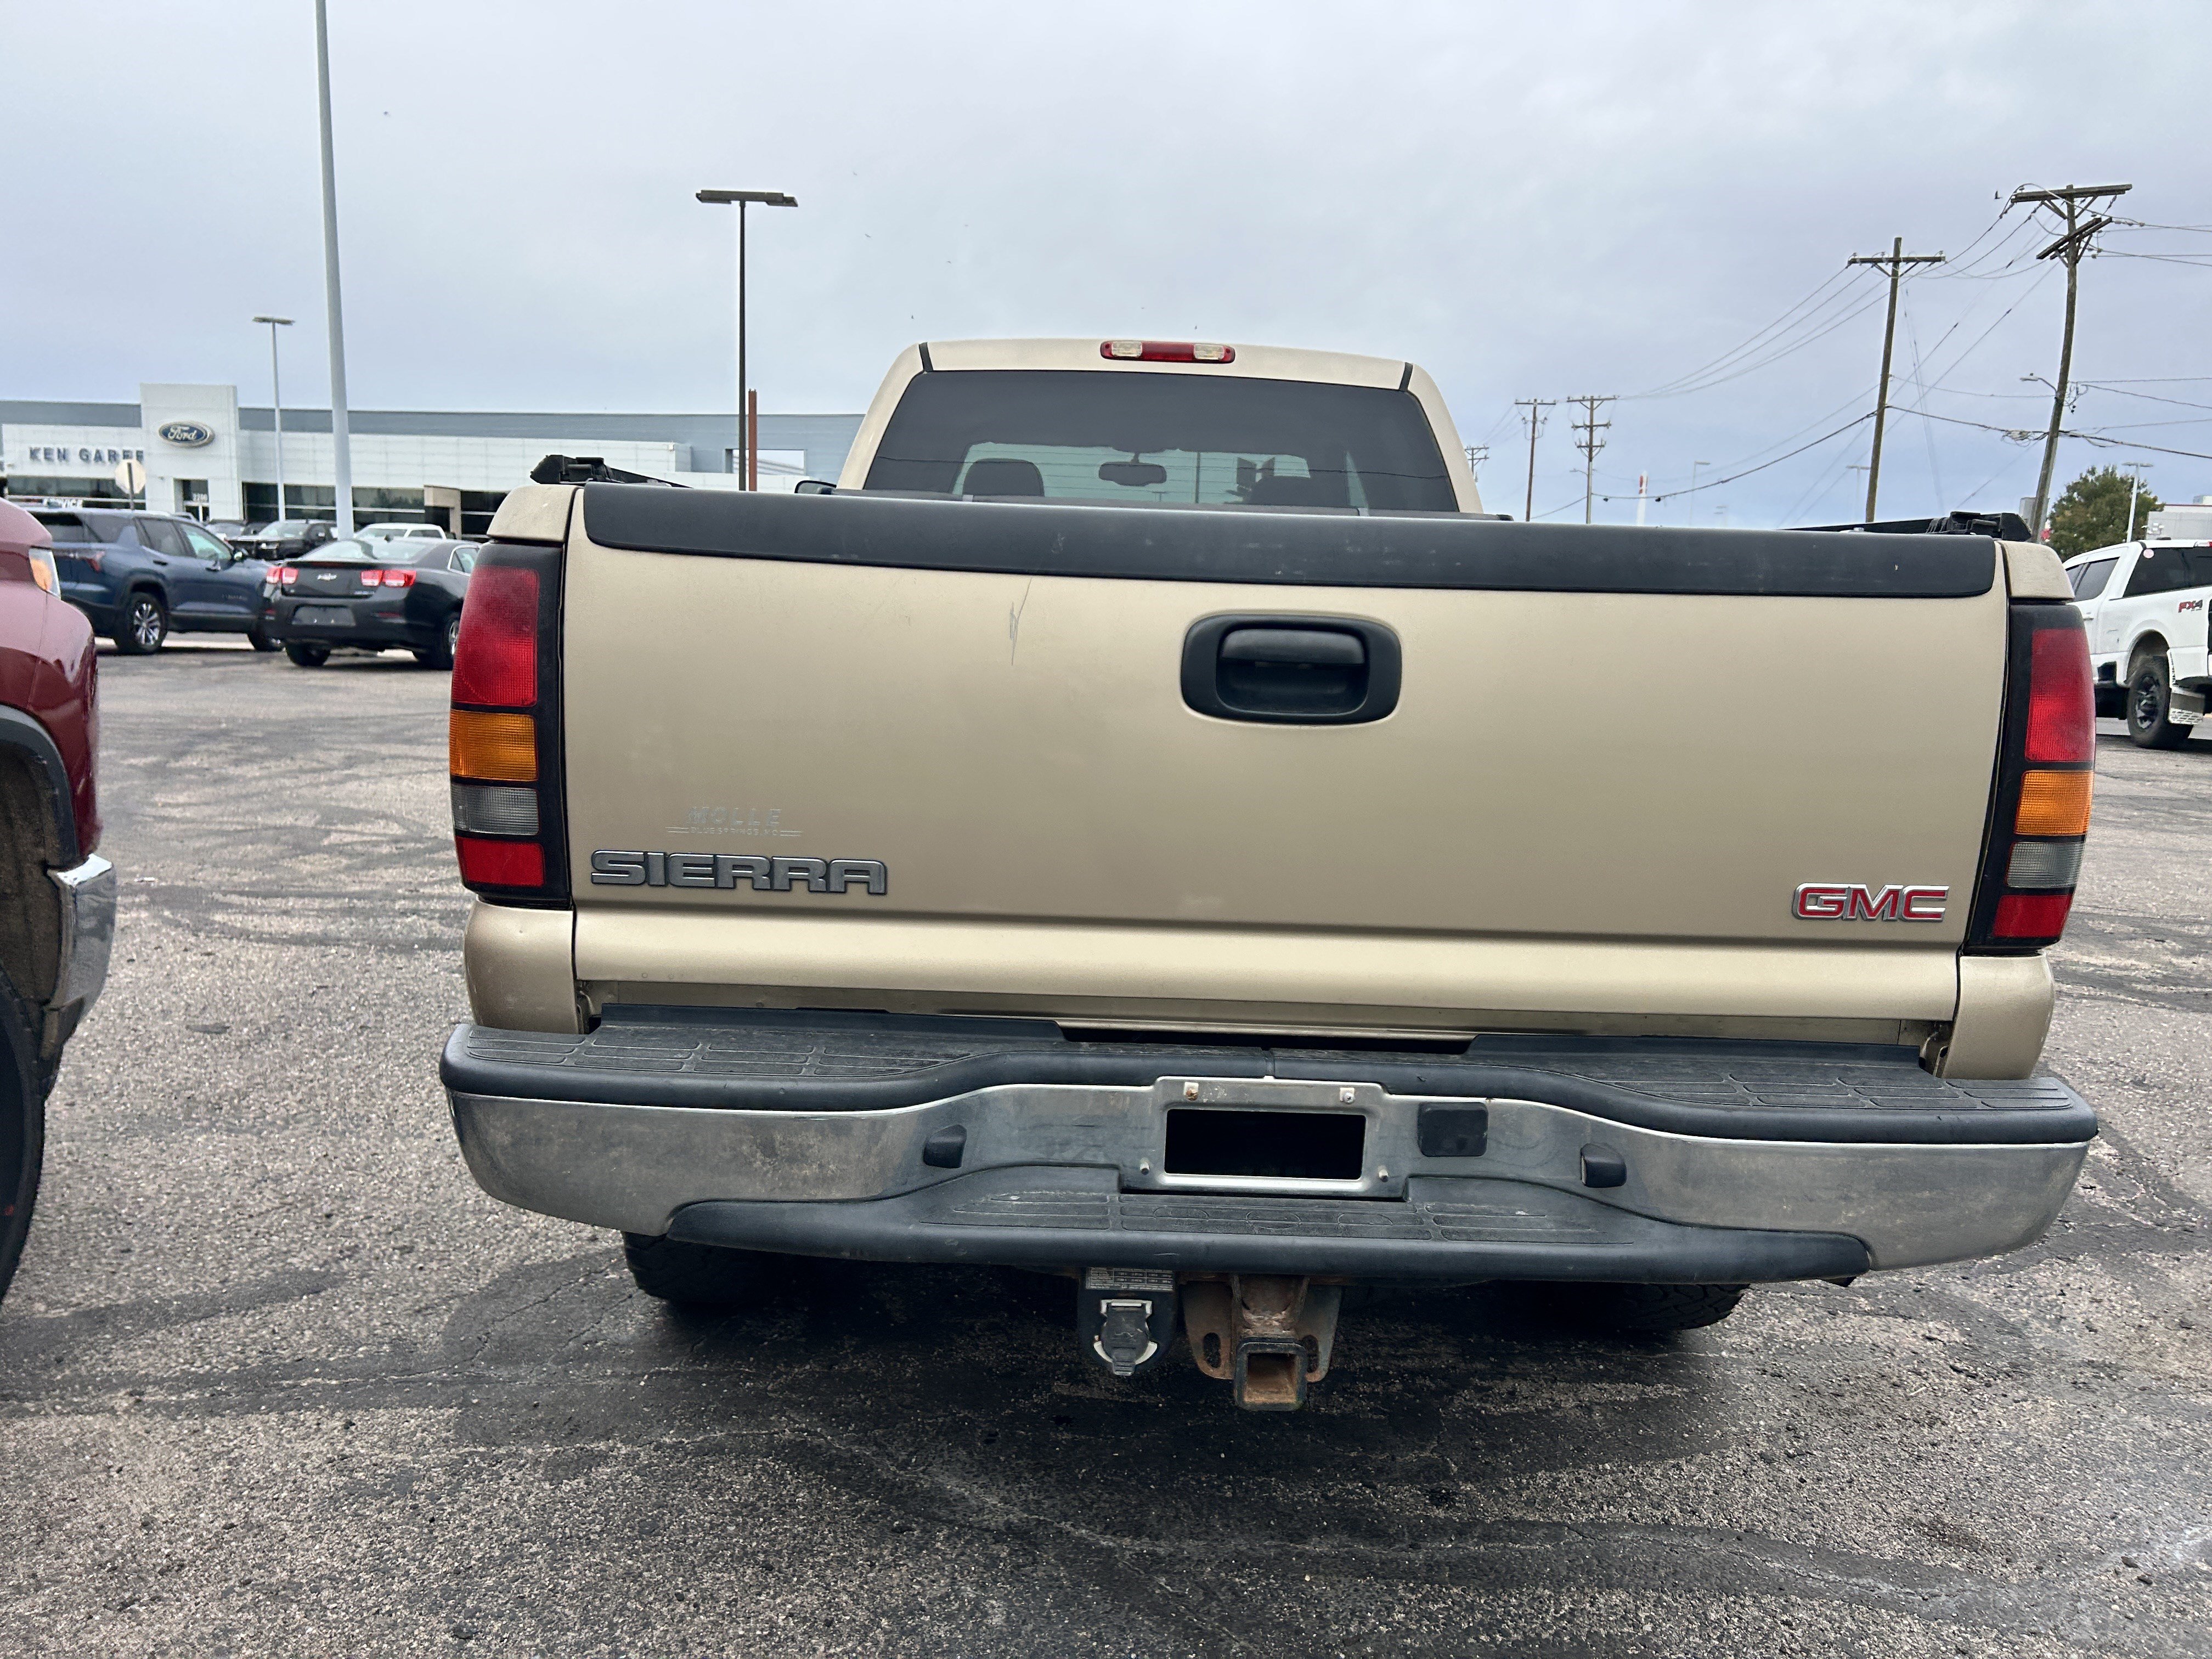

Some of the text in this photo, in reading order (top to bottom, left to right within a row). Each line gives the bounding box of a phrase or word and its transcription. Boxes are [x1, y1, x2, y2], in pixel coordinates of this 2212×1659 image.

[29, 447, 69, 462] KEN
[2178, 600, 2203, 613] FX4
[591, 849, 888, 895] SIERRA
[1792, 882, 1950, 921] GMC
